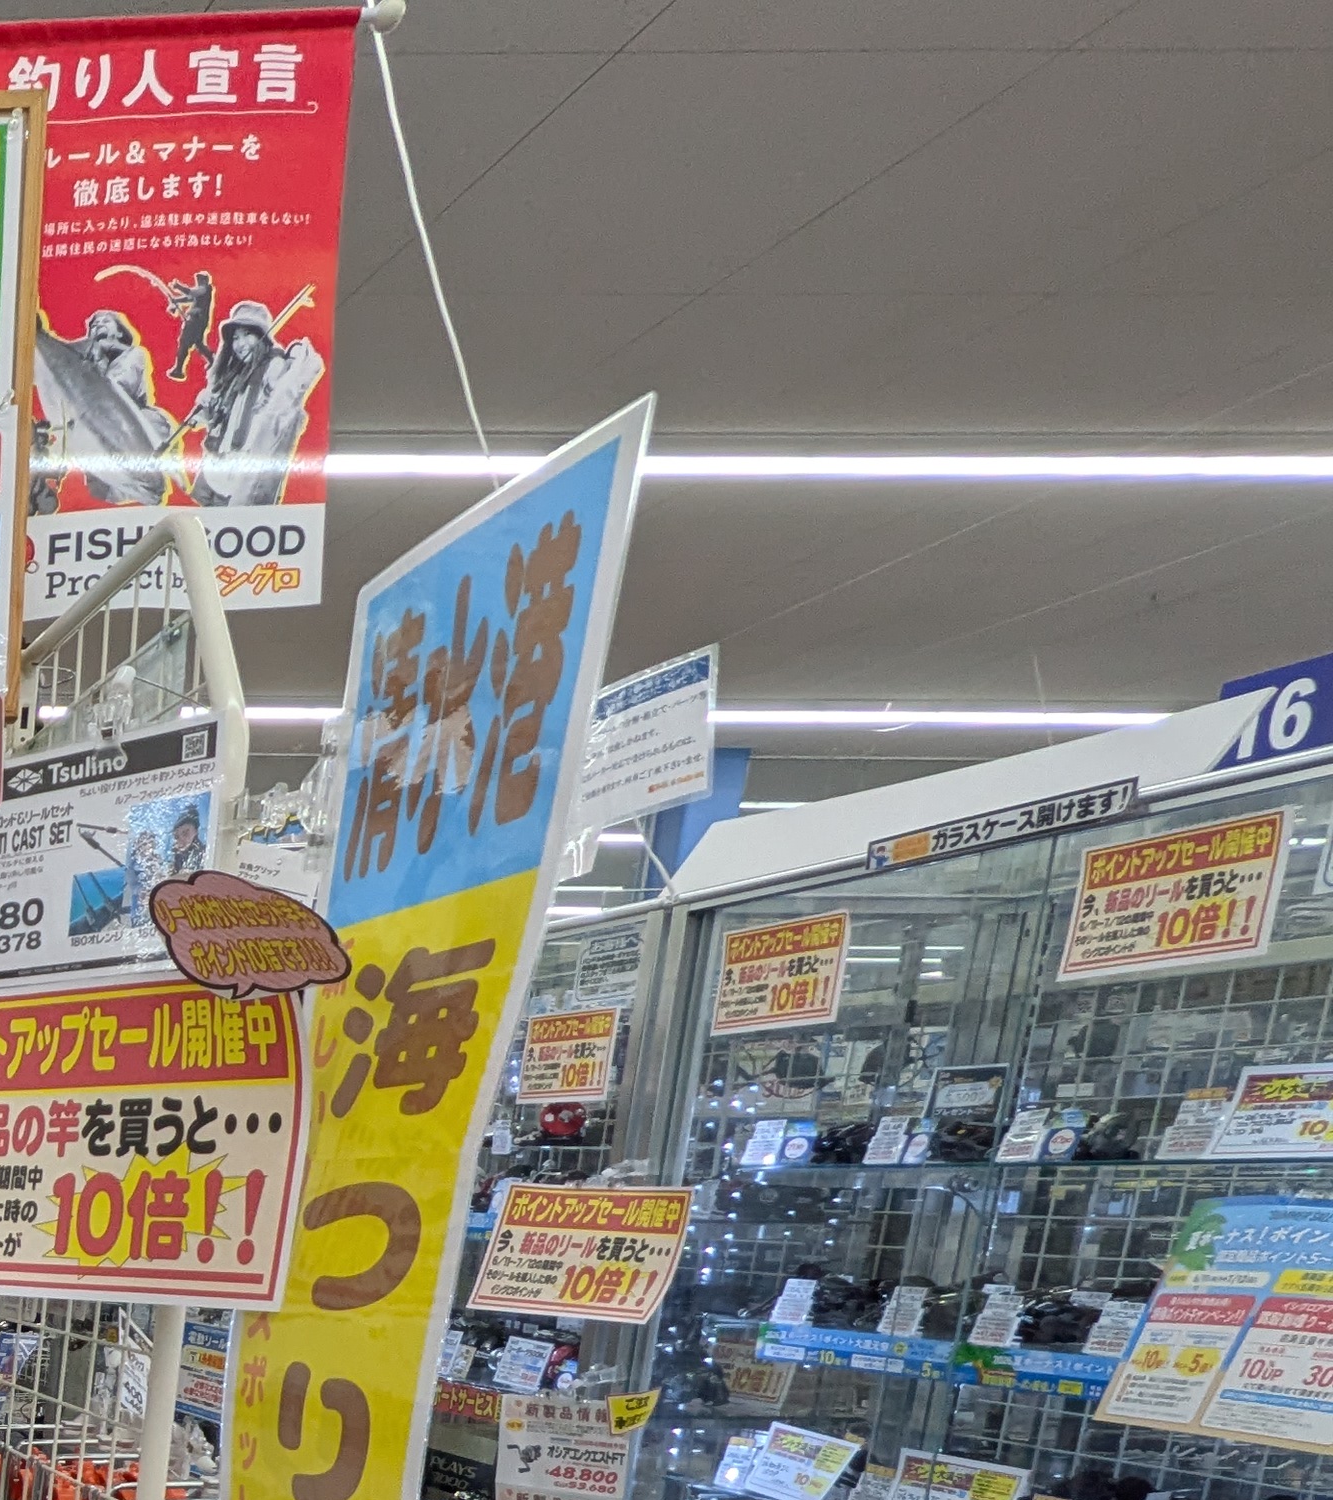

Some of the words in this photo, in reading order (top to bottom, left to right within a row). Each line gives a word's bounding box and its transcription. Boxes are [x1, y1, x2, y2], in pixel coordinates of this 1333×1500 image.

[8, 44, 303, 111] 釣り人宣言
[73, 172, 223, 207] 徹底します!
[343, 509, 583, 882] 清水港
[48, 755, 128, 785] Tsulino
[12, 827, 44, 854] CAST
[50, 820, 73, 846] SET
[931, 786, 1130, 852] ガラスケース開けます!
[1157, 898, 1257, 948] 10倍!!
[51, 1169, 268, 1266] 10倍!!
[558, 1265, 658, 1307] 10倍!!
